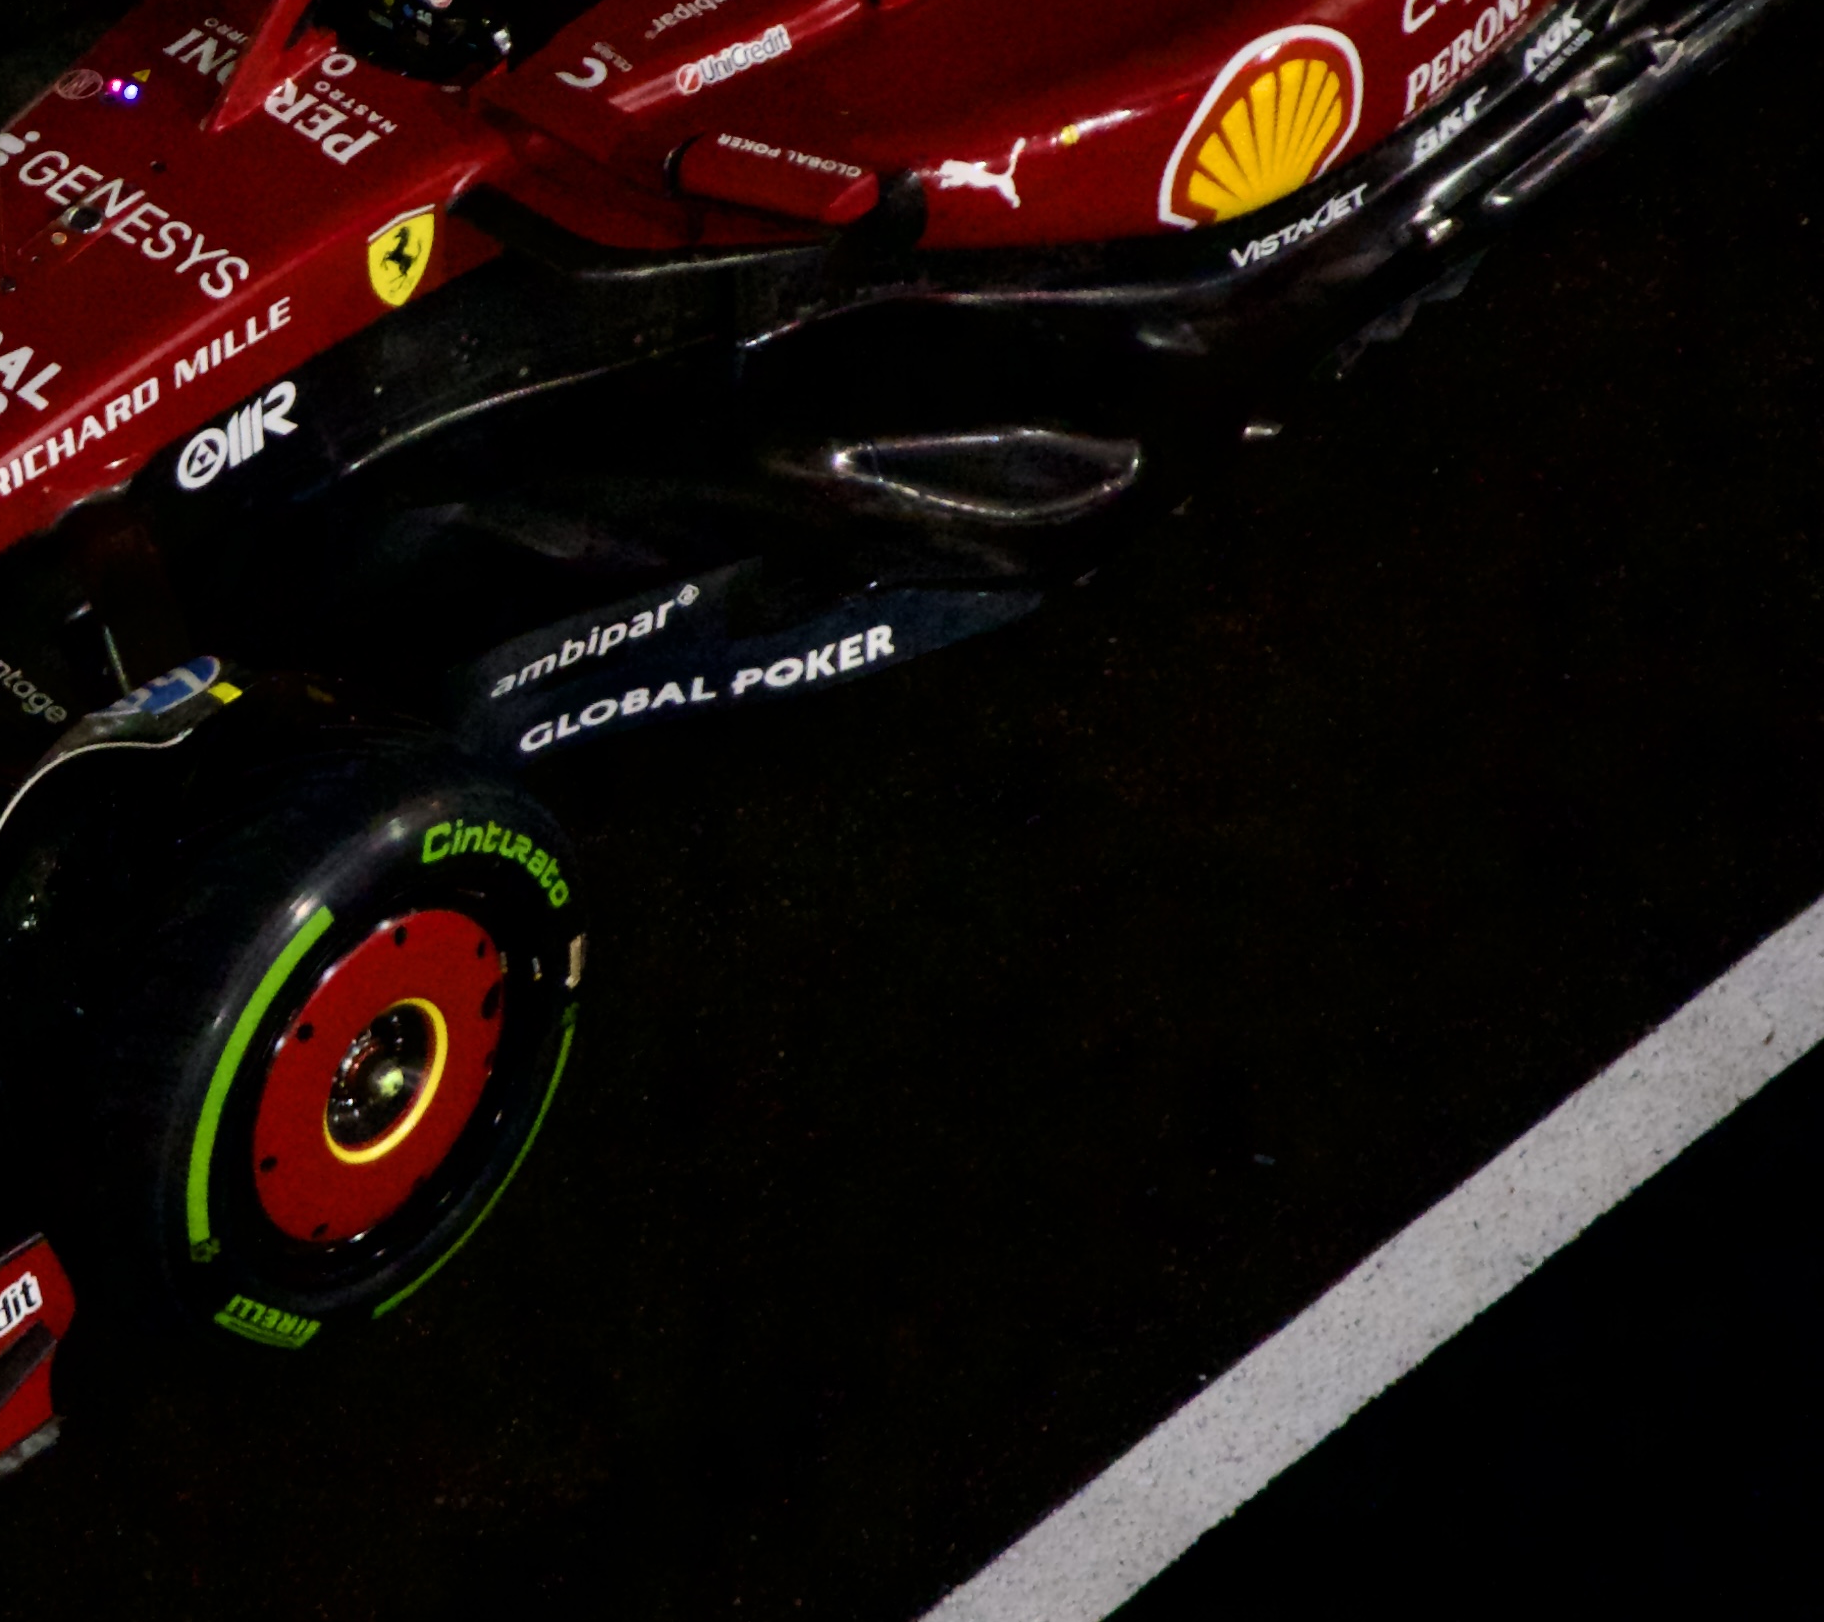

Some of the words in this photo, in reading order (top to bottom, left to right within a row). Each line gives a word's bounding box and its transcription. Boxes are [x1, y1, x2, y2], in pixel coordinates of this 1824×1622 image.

[698, 25, 794, 84] UniCredit
[312, 80, 399, 135] NASTRO
[16, 149, 251, 301] GENESYS
[173, 295, 293, 391] MILLE
[518, 676, 718, 753] GLOBAL
[730, 623, 896, 697] POKER
